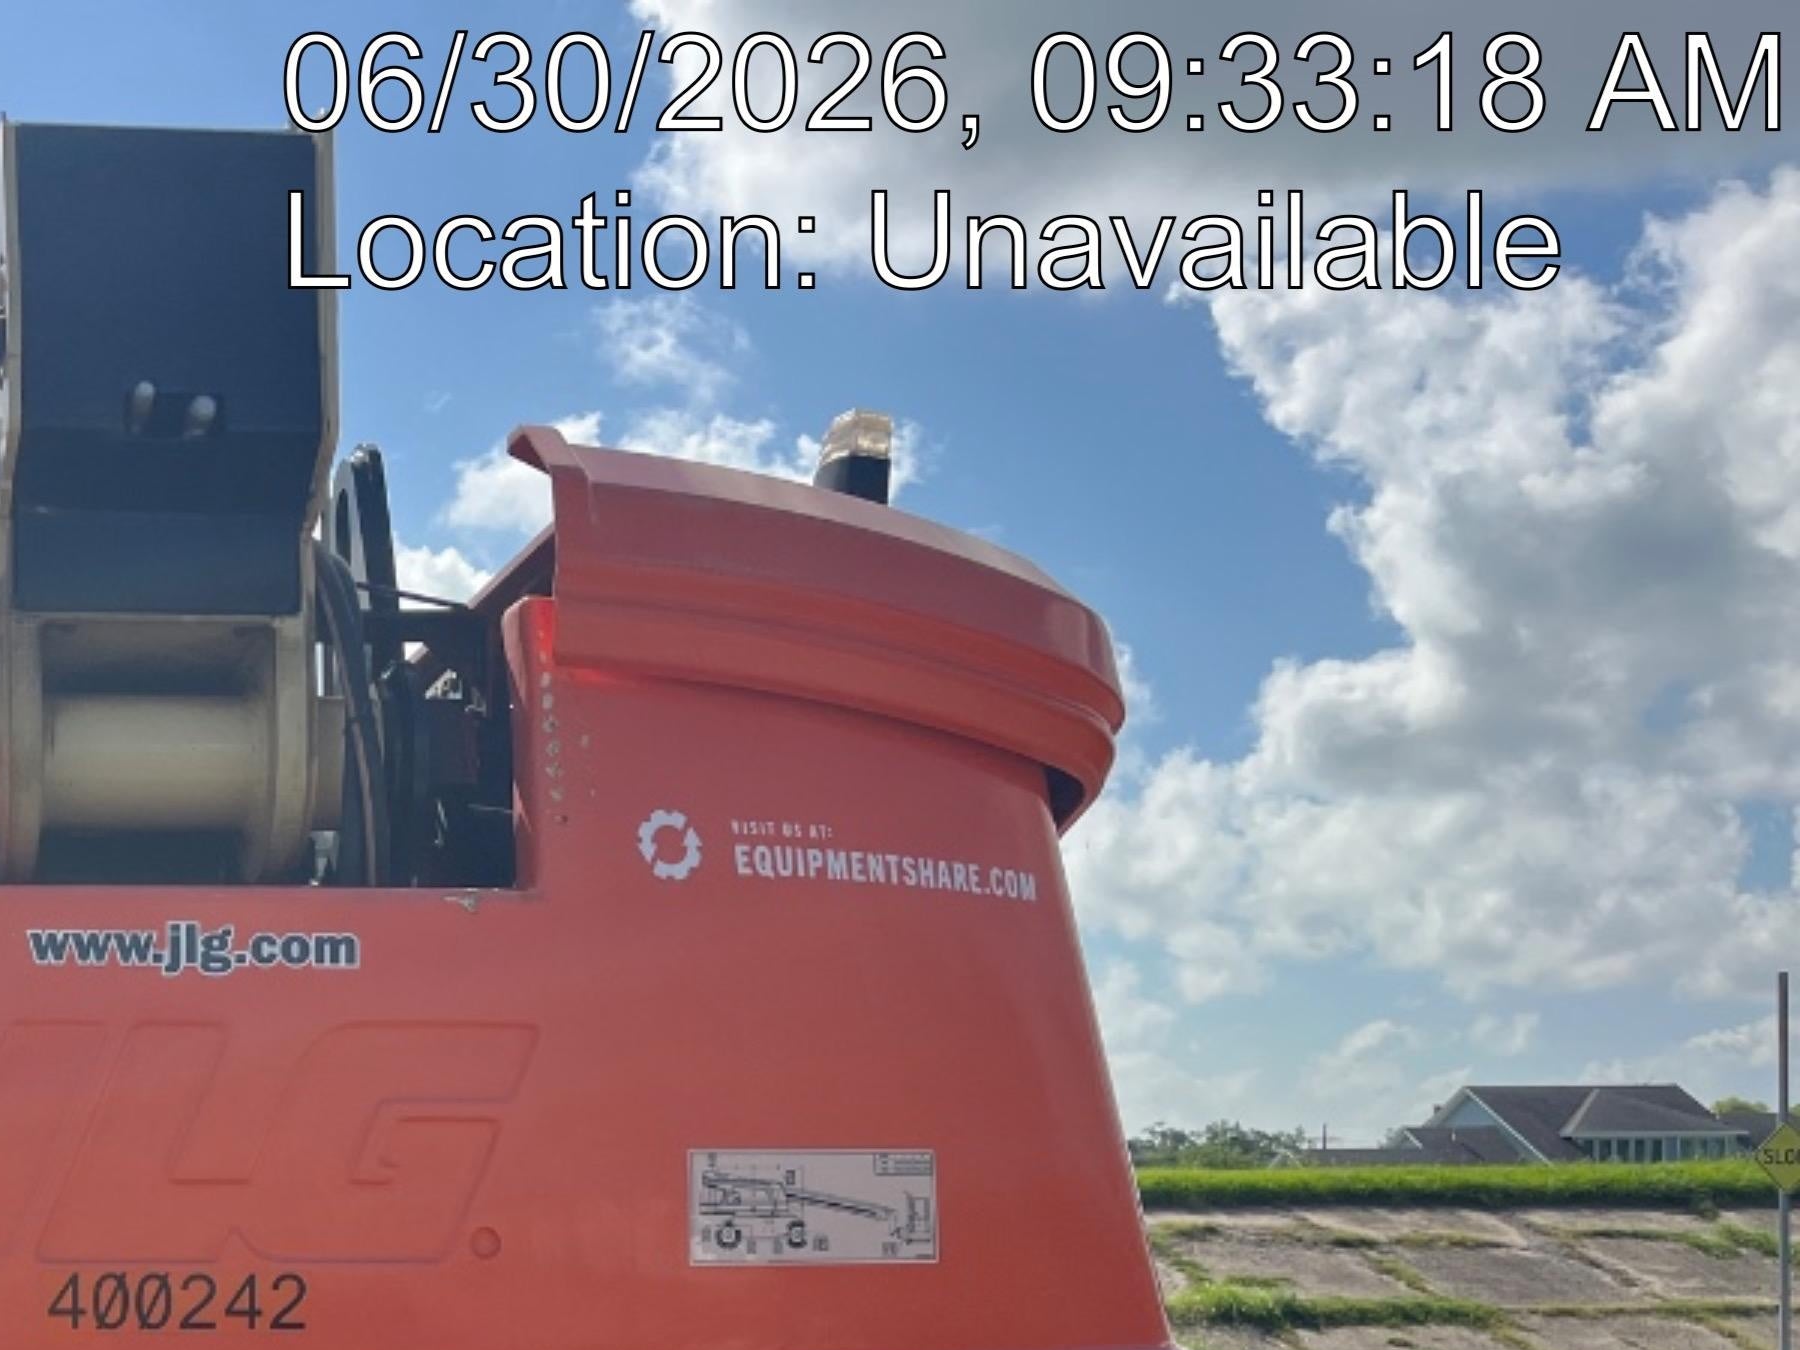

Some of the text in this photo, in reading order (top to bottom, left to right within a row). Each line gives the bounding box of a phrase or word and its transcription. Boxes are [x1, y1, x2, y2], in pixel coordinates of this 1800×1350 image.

[734, 844, 1037, 901] EQUIPMENTSHARE.COM
[26, 923, 359, 975] www.jlg.com
[47, 1272, 308, 1331] 400242
